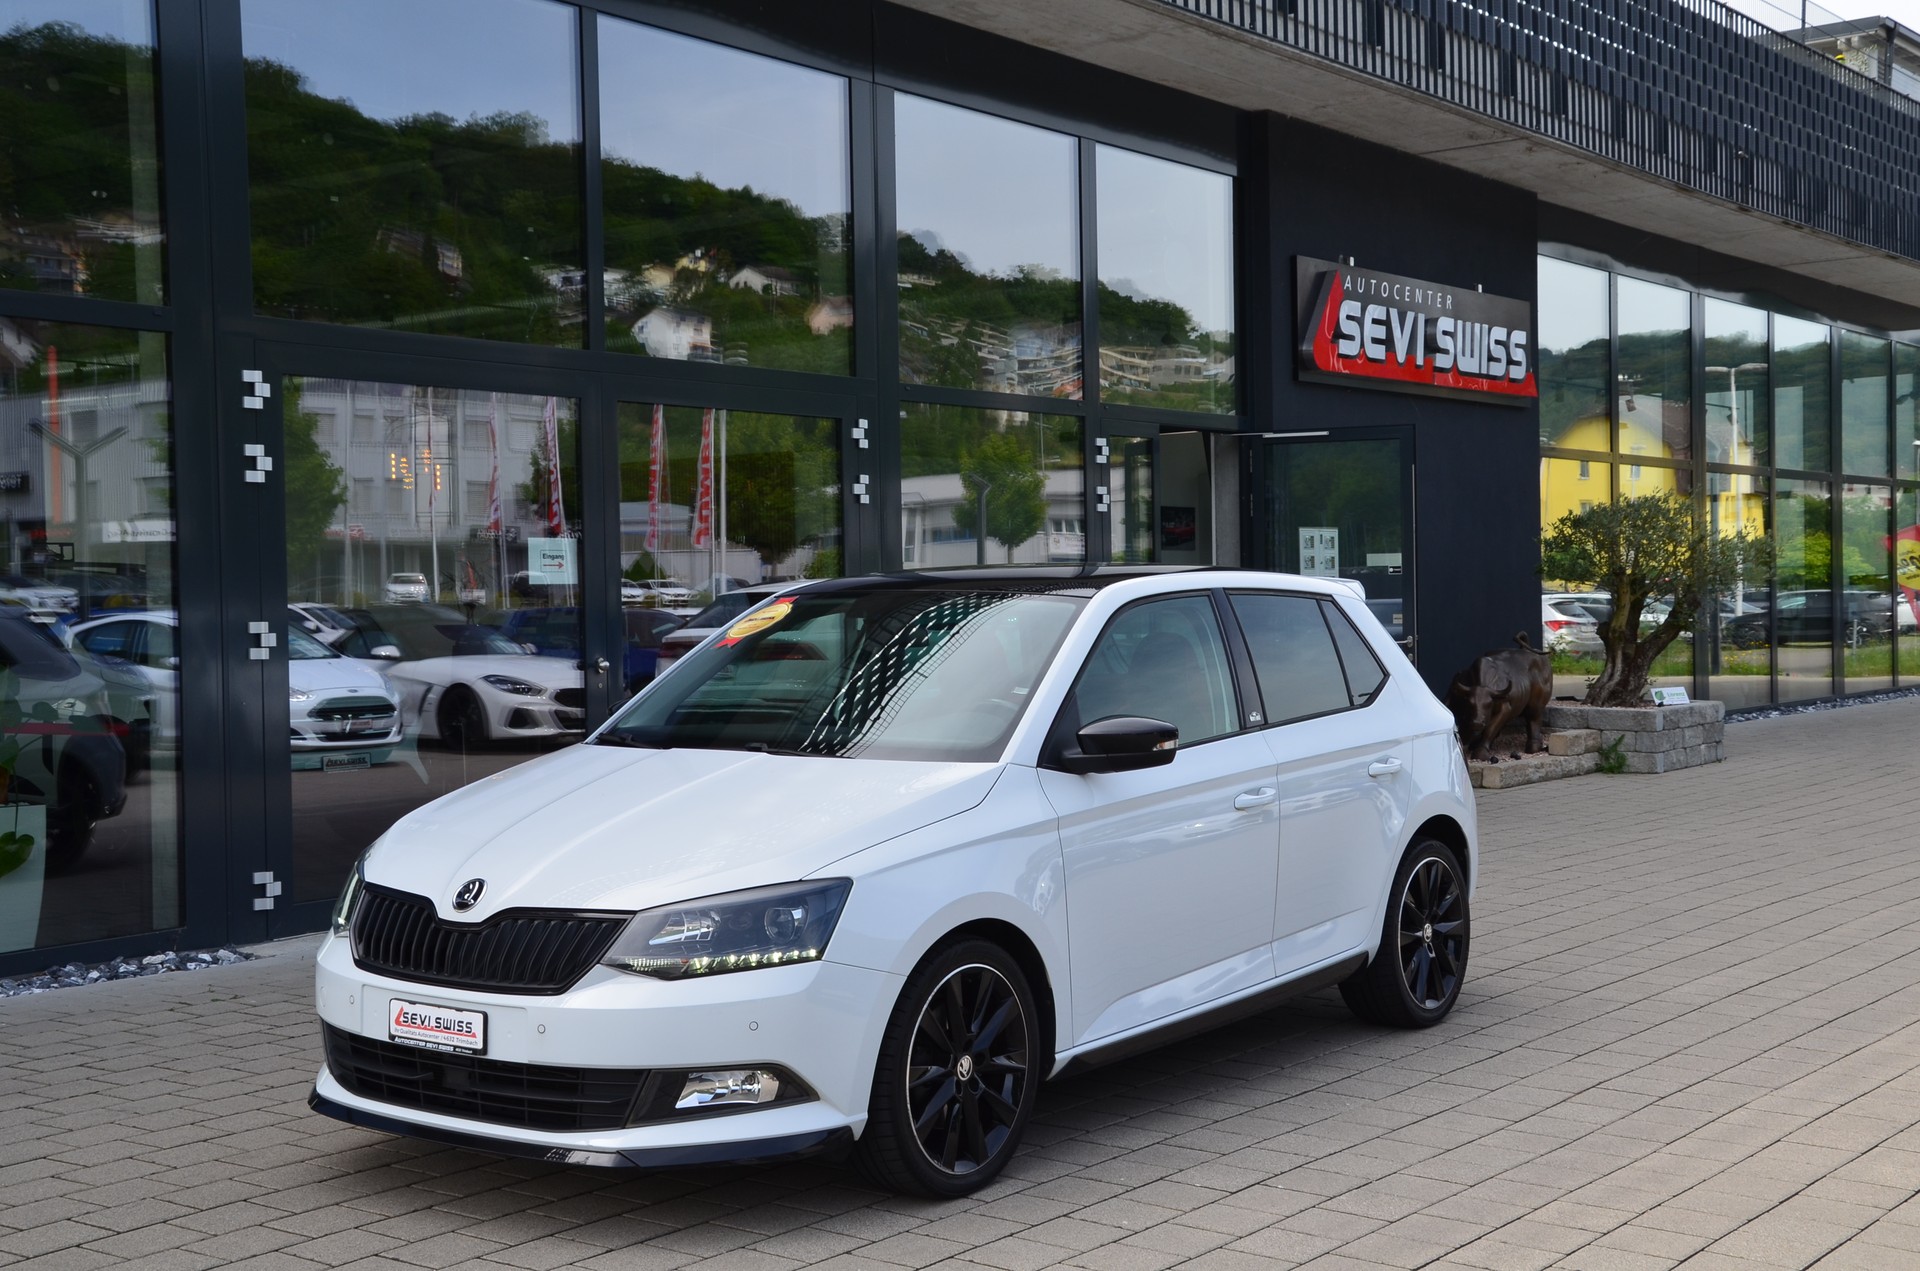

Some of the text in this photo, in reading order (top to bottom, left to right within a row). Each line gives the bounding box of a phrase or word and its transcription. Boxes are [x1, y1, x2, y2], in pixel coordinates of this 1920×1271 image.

[1343, 275, 1453, 310] AUTOCENTER
[1338, 299, 1527, 380] SEVI SWISS
[543, 553, 564, 561] Eingang
[402, 1011, 473, 1034] SEVI SWISS
[417, 1031, 440, 1039] Autocenter
[456, 1037, 479, 1046] Trimbach
